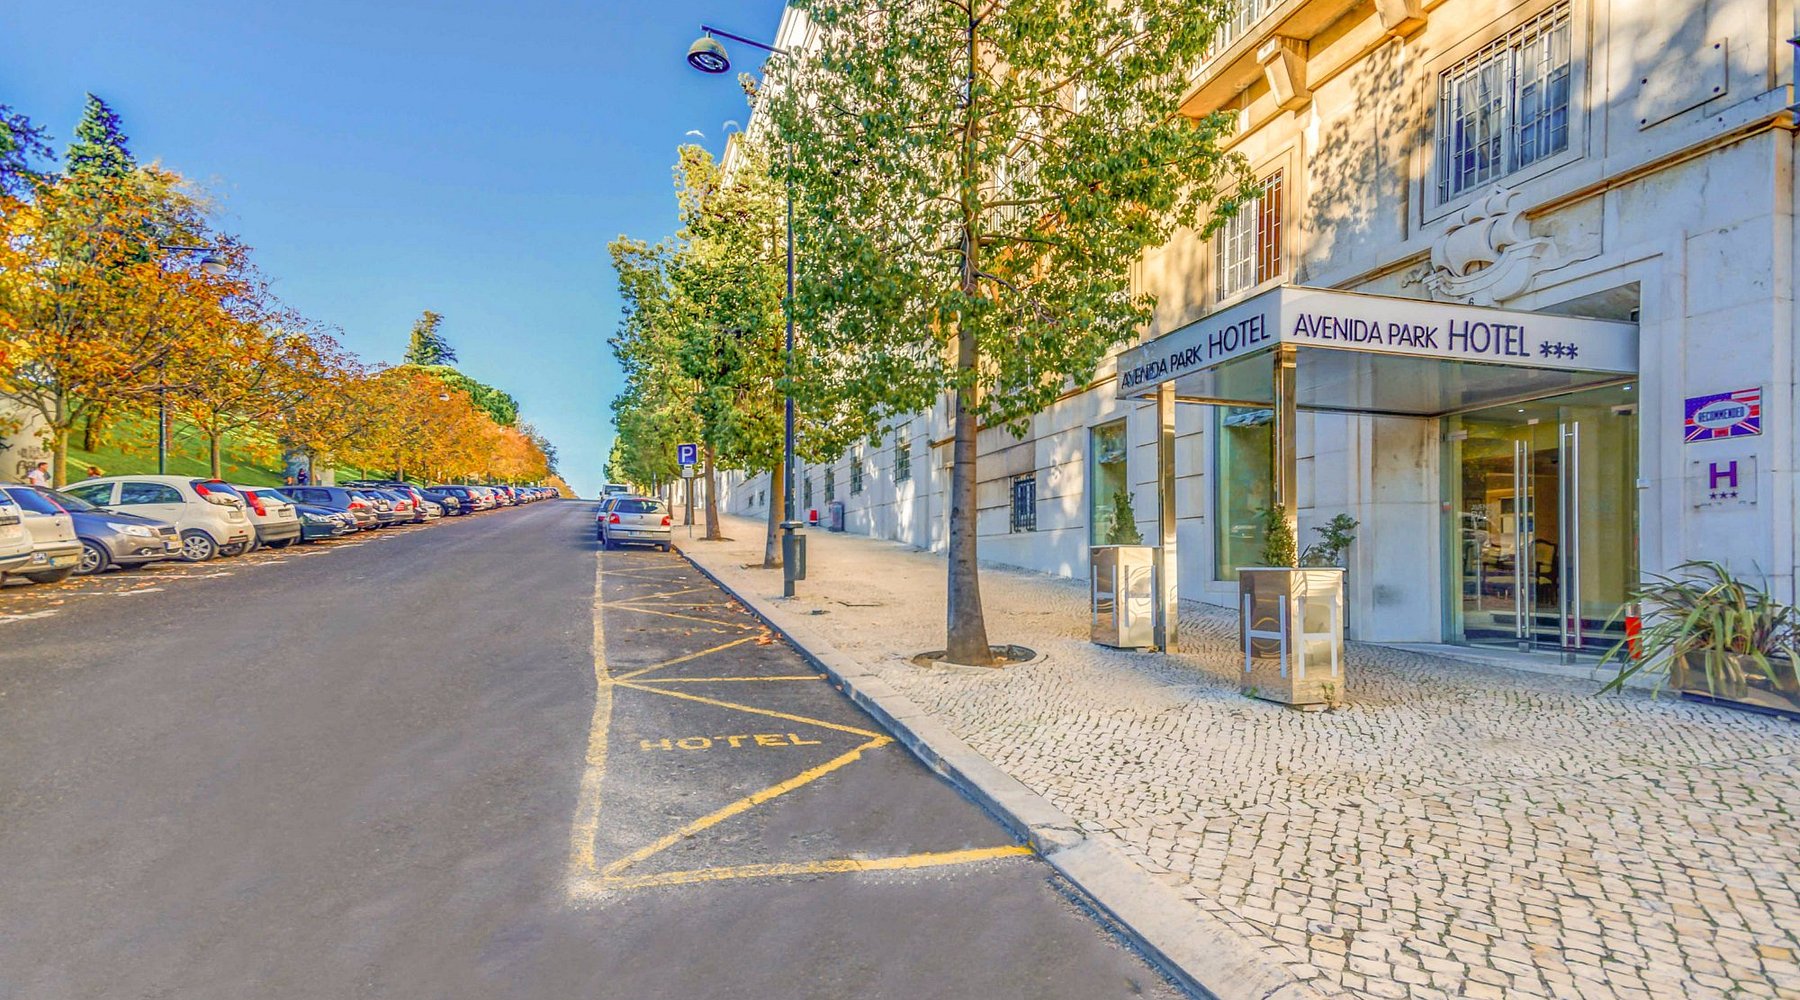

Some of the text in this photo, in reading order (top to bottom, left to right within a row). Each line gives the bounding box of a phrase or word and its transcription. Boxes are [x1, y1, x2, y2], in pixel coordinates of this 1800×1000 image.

[1293, 313, 1530, 357] AVENIDA PARK HOTEL
[1121, 313, 1271, 389] AVENIDA PARK HOTEL
[681, 446, 693, 463] P
[1709, 461, 1738, 489] H
[640, 733, 822, 750] HOTEL
